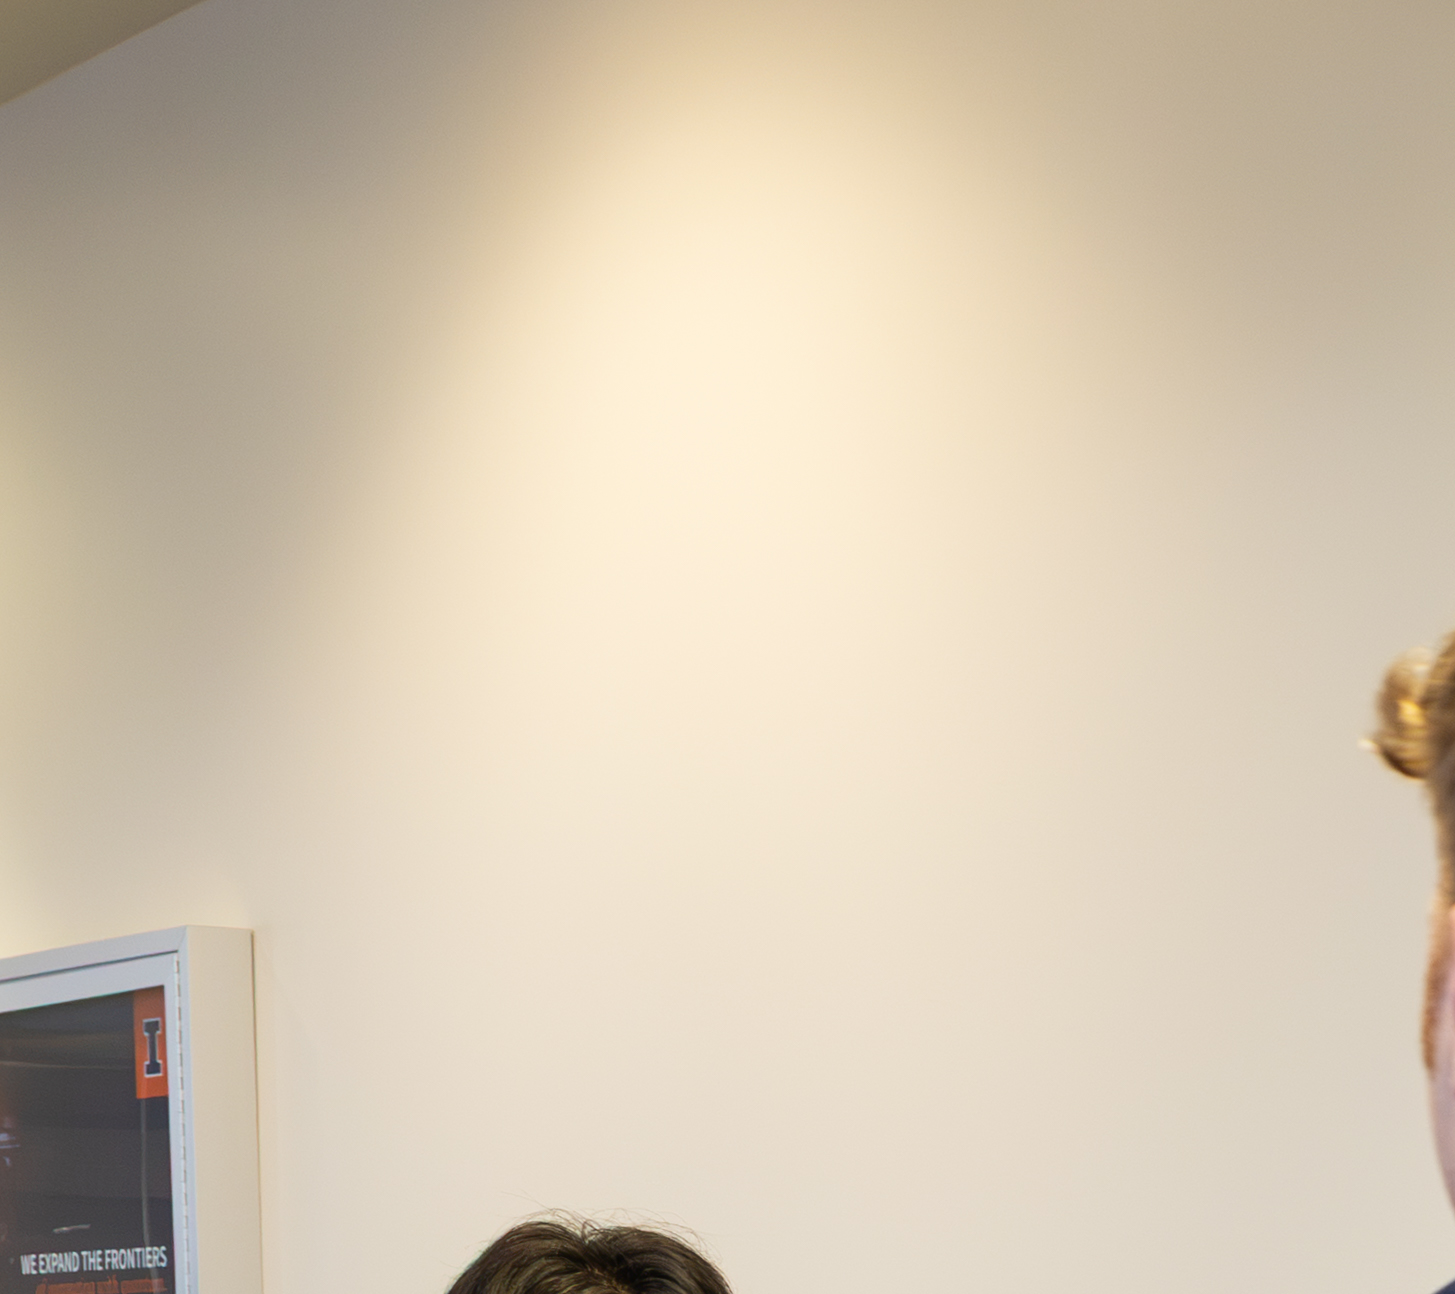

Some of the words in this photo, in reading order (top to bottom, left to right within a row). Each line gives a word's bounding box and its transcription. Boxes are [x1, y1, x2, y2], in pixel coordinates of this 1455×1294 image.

[20, 1254, 38, 1275] WE
[39, 1251, 80, 1274] EXPAND
[81, 1250, 103, 1271] THE
[105, 1246, 167, 1270] FRONTIERS
